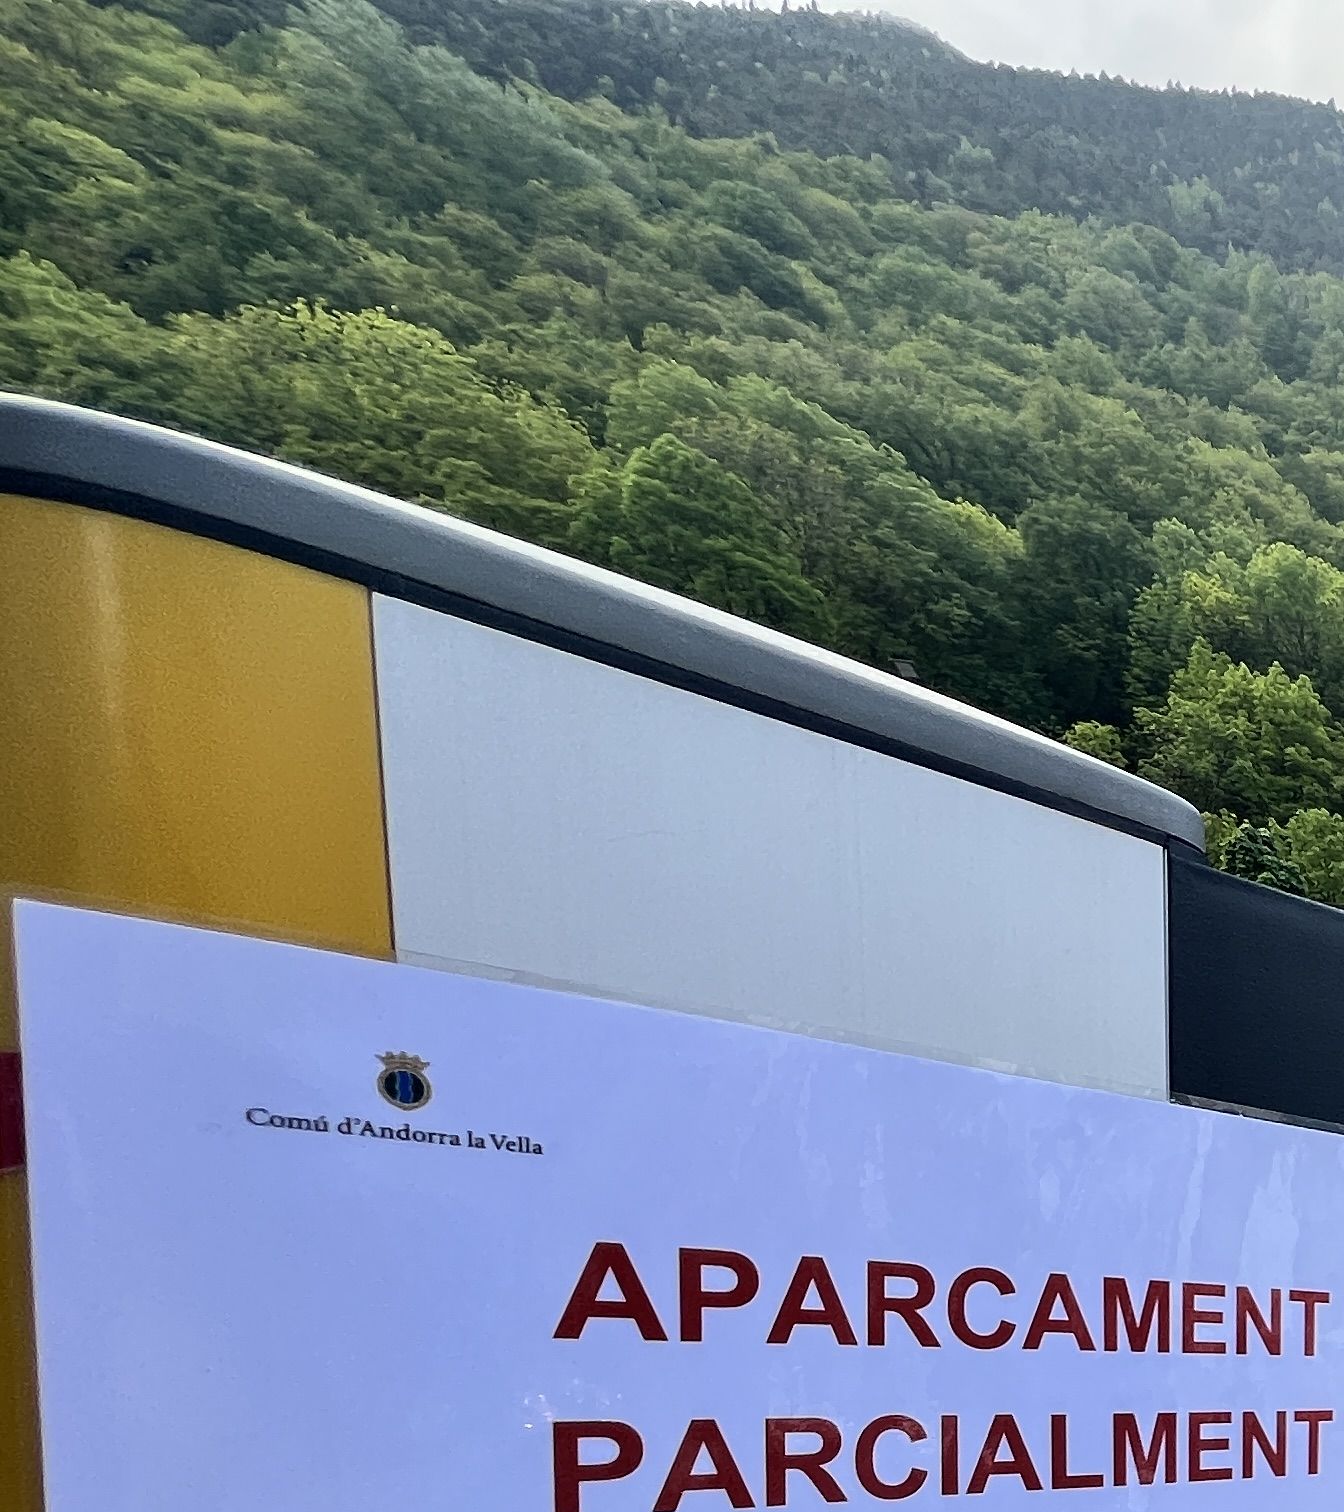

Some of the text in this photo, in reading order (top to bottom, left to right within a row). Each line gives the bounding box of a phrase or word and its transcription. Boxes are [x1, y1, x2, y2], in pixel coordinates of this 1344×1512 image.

[246, 1108, 543, 1155] Comú d'Andorra la Vella
[552, 1242, 1329, 1356] APARCAMENT
